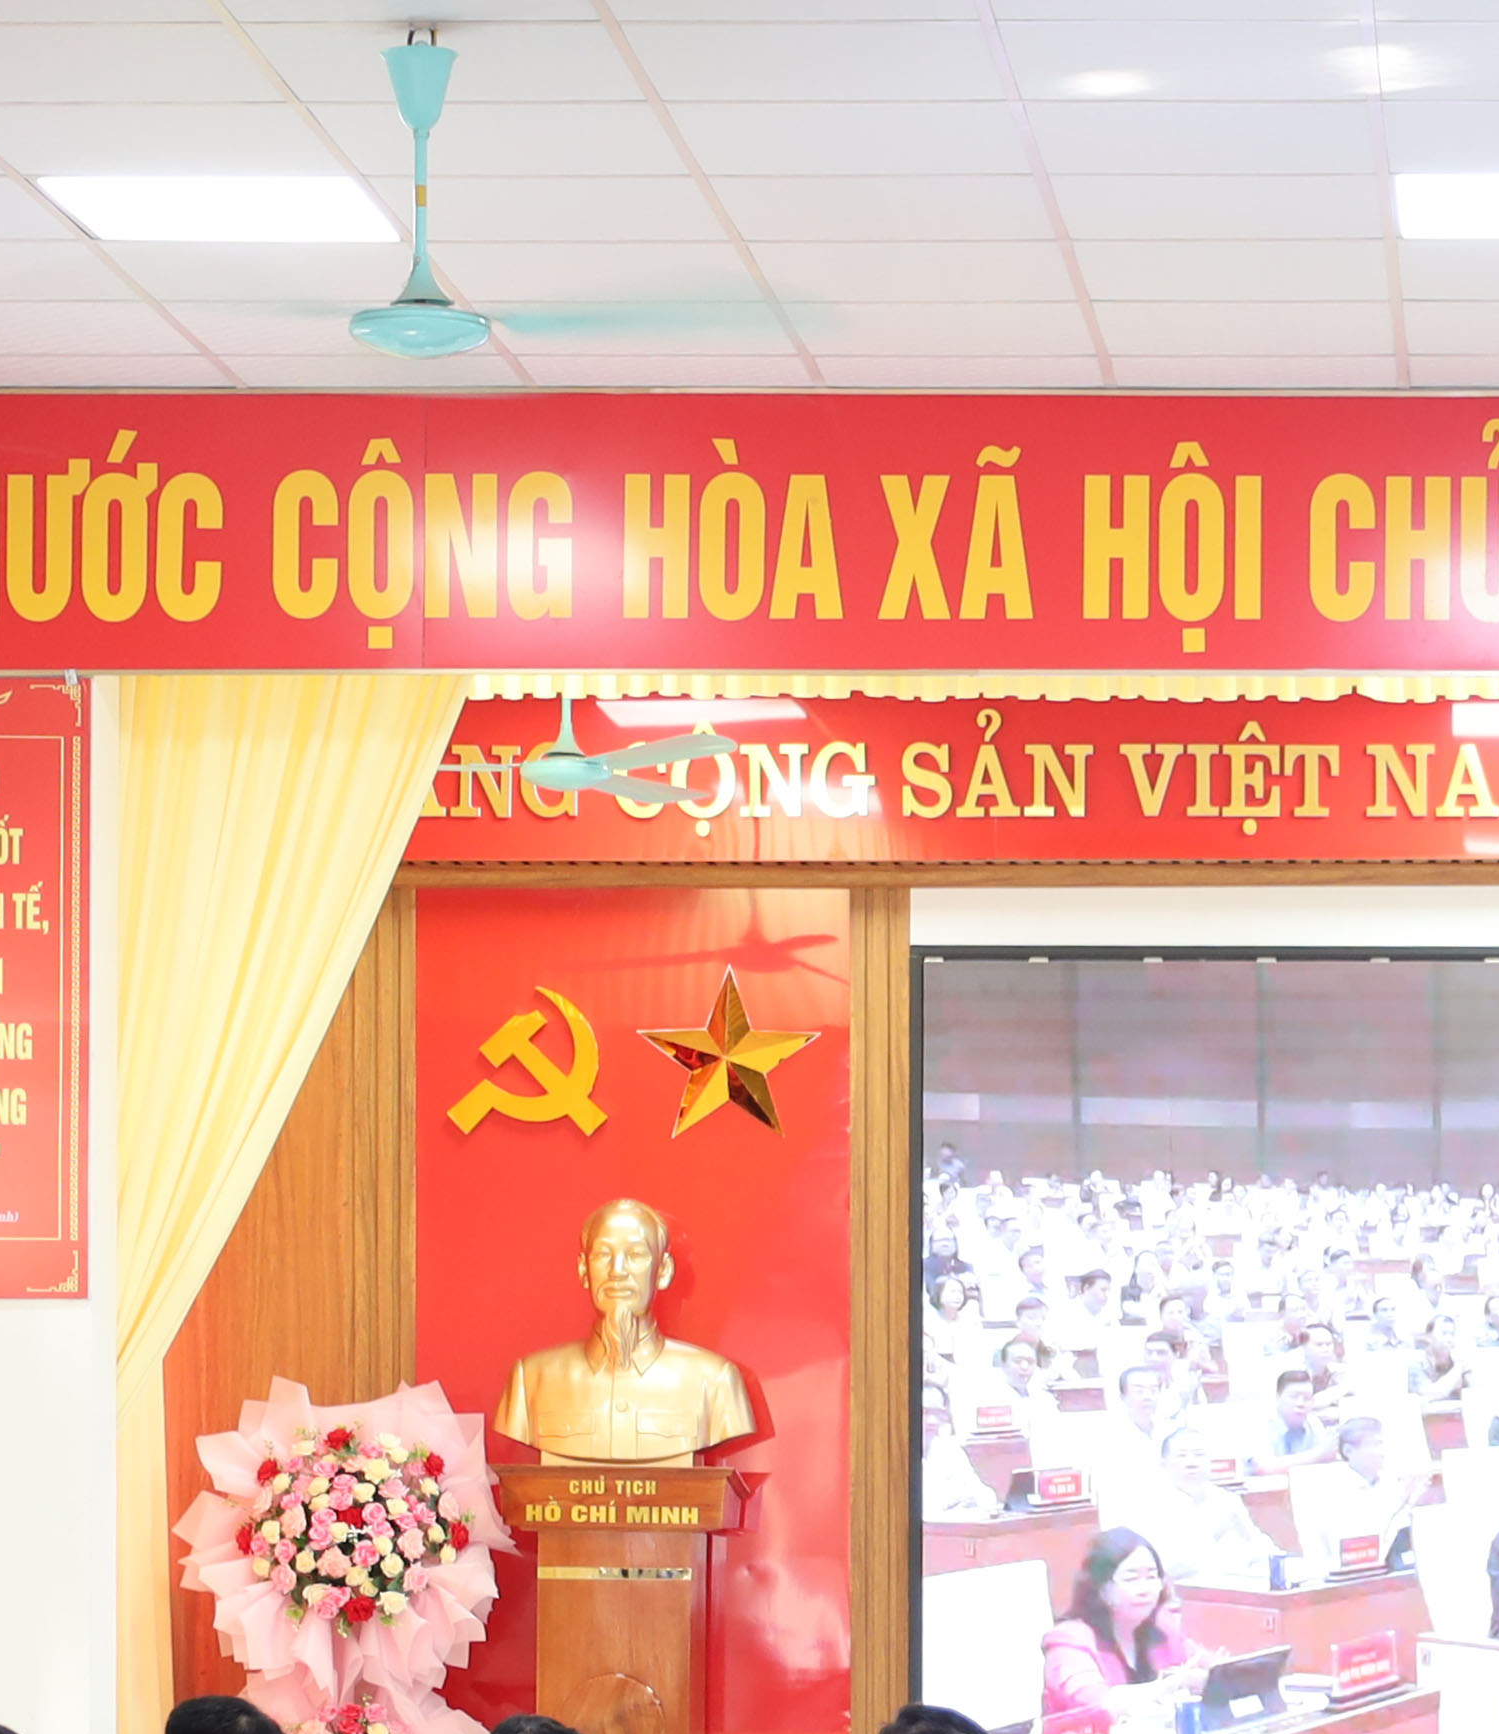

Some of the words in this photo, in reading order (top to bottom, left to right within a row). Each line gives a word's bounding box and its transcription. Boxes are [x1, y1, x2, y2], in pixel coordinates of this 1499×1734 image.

[272, 437, 575, 650] CỘNG
[623, 437, 844, 622] HÒA
[876, 444, 1034, 621] XÃ
[1082, 440, 1263, 654] HỘI
[419, 741, 579, 818] NG
[901, 708, 1095, 819] SẢN
[1119, 719, 1340, 836] VIỆT
[11, 881, 50, 935] TẾ,
[526, 1495, 562, 1522] HỒ
[571, 1499, 616, 1524] CHÍ
[626, 1506, 699, 1525] MINH
[569, 1475, 605, 1495] CHỦ
[615, 1479, 656, 1497] TỊCH
